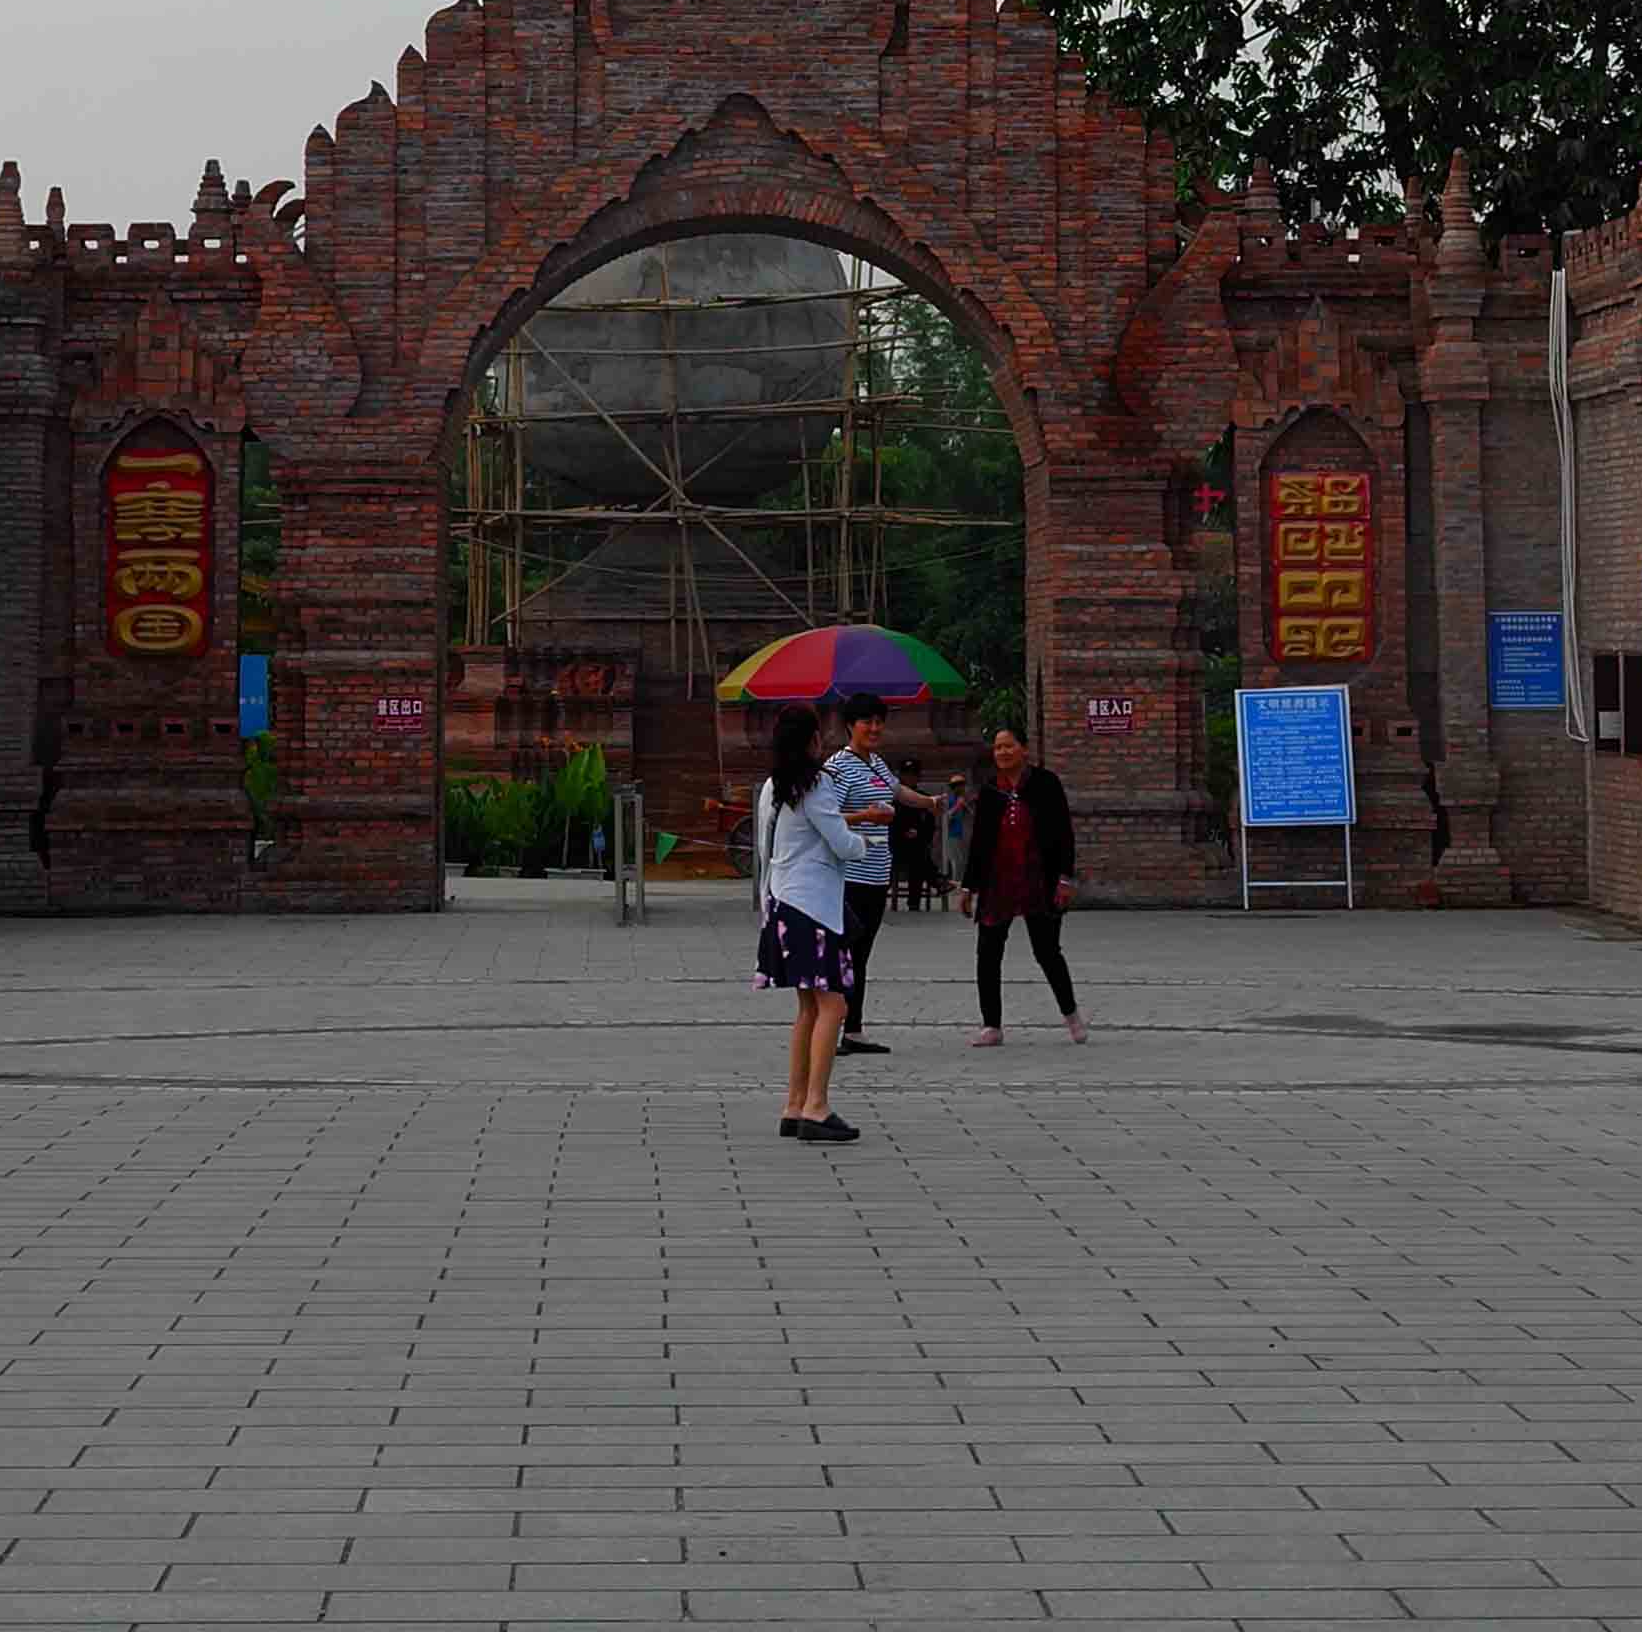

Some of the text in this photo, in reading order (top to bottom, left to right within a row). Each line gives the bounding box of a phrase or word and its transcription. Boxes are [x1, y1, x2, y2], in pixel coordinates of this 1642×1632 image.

[377, 698, 422, 715] 景区出口
[1088, 699, 1133, 716] 景区入口
